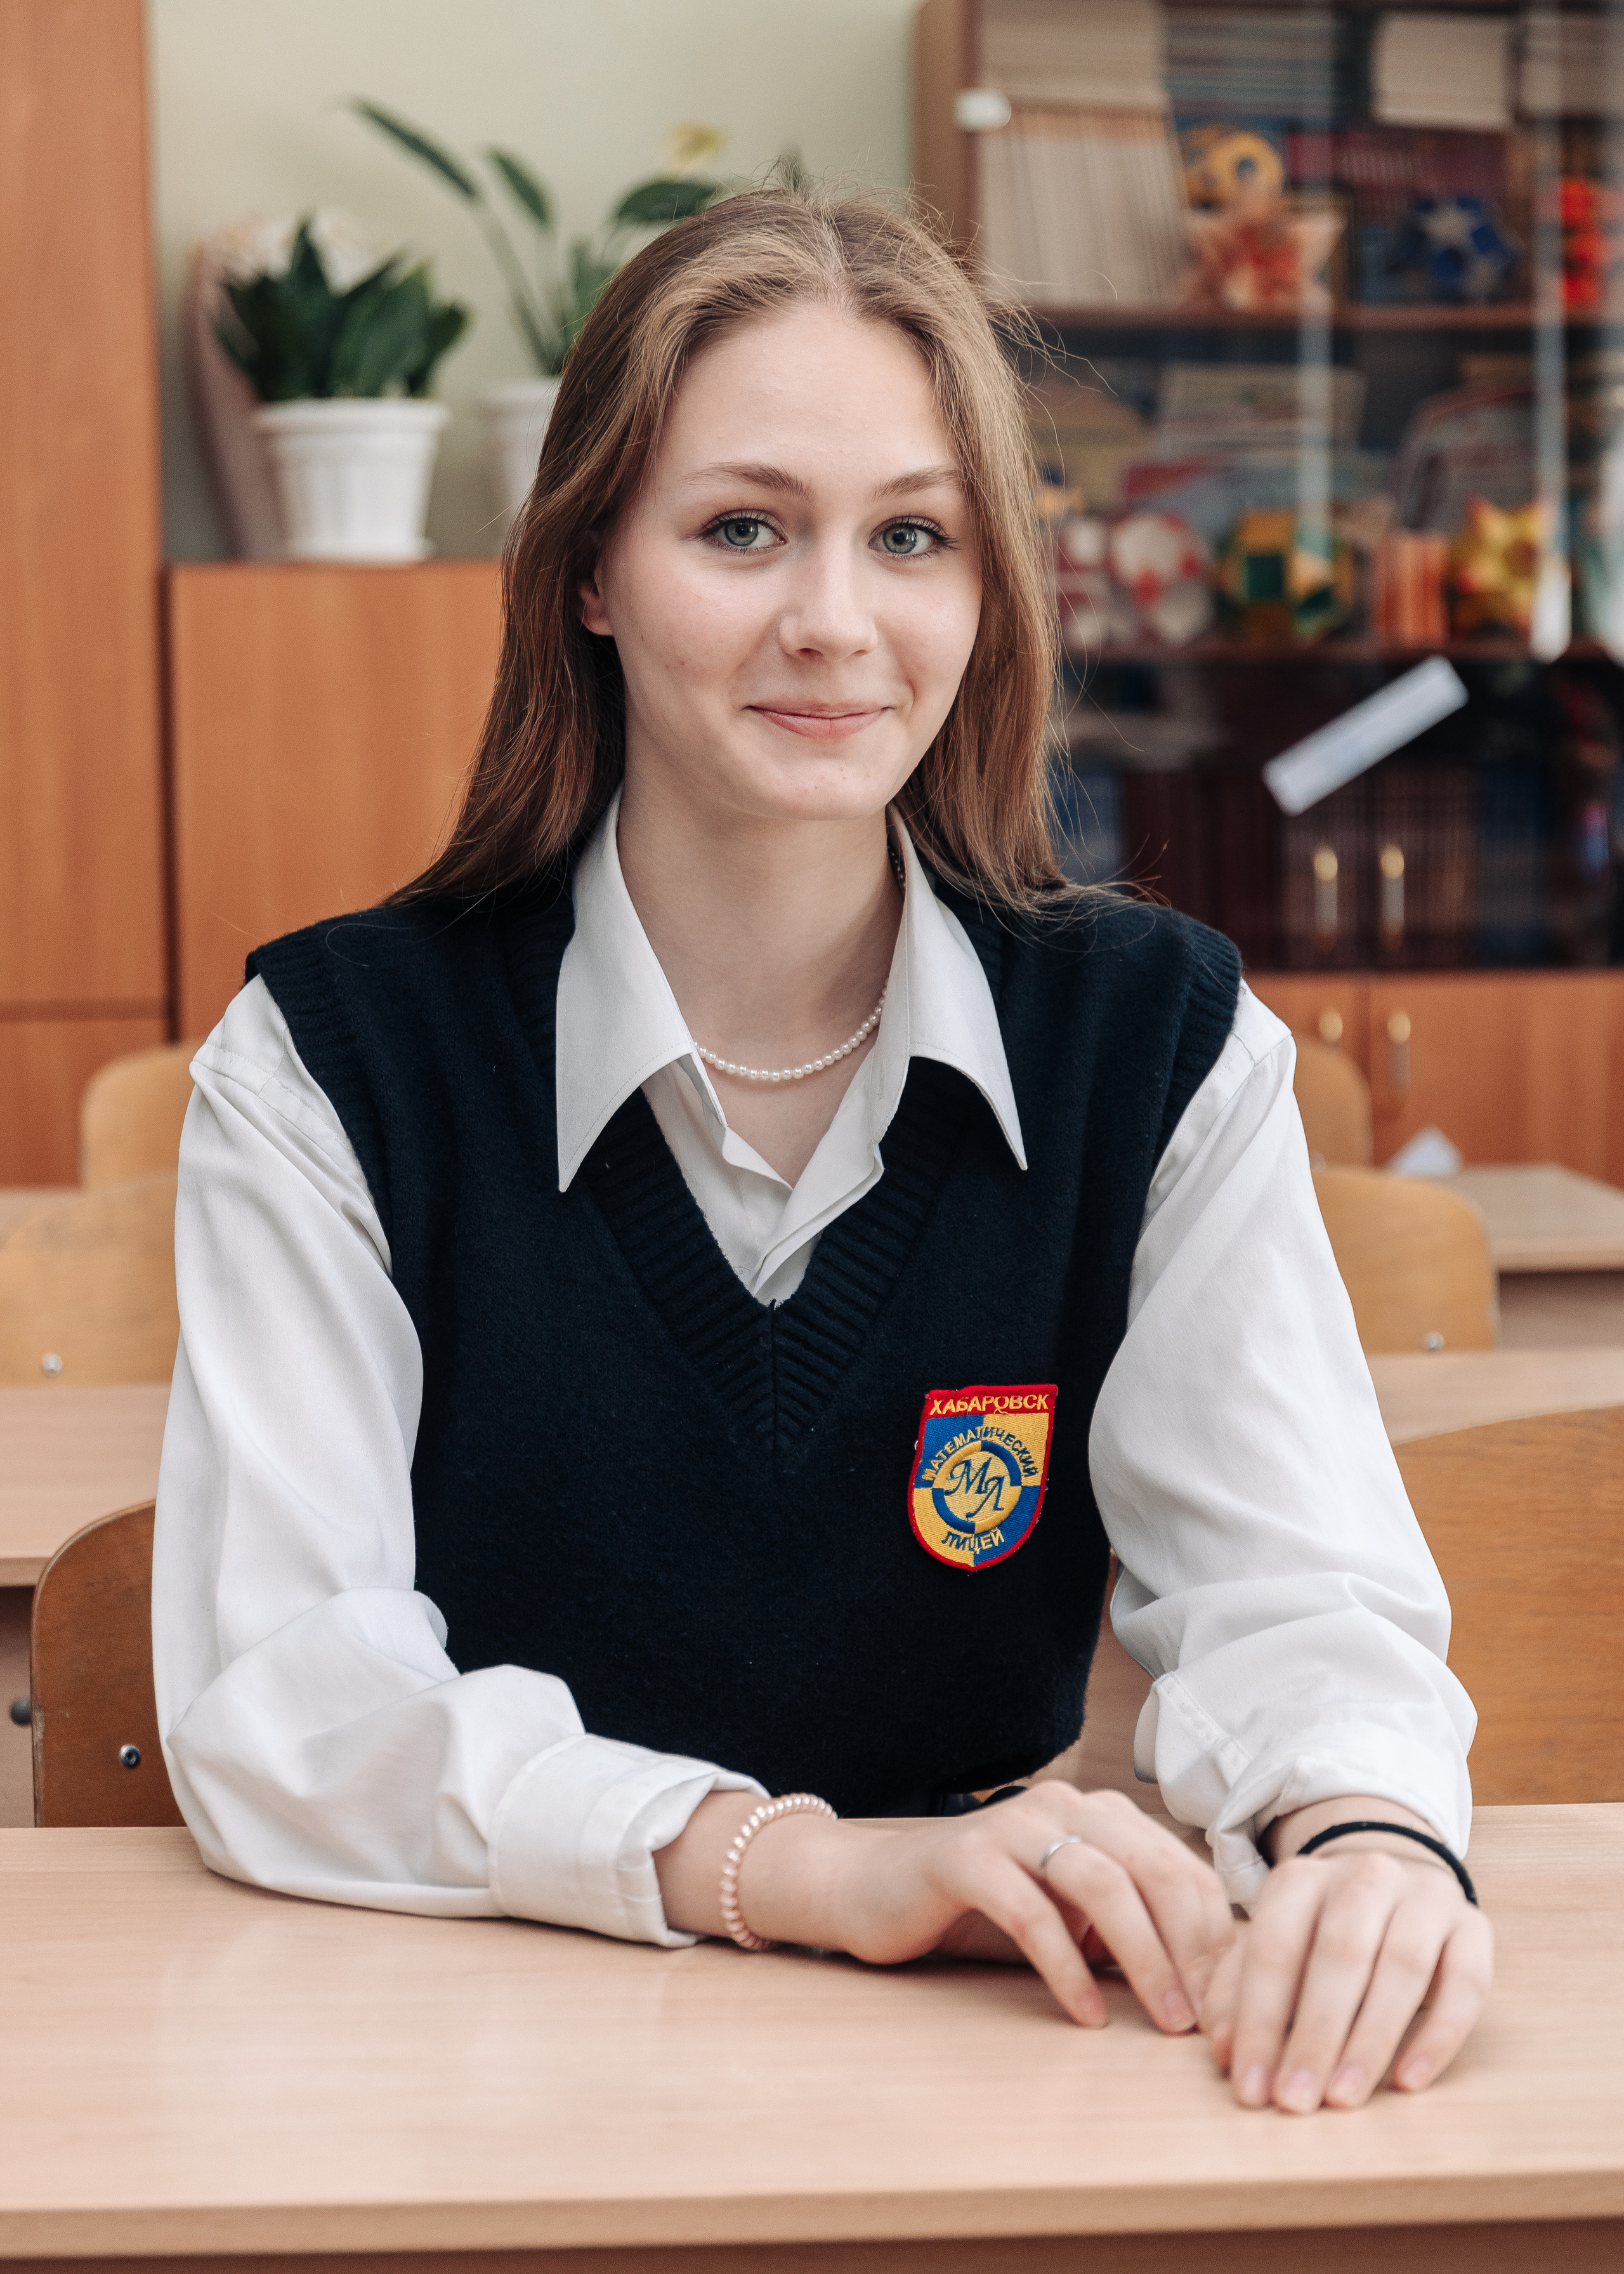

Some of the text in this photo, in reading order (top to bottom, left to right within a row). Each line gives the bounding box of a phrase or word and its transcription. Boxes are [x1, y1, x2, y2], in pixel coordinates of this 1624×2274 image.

[930, 1394, 1050, 1416] ХАБАРОВСК
[922, 1426, 1038, 1481] МАТЕМАТИЧЕСКИЙ
[941, 1527, 1004, 1554] ЛИЦЕЙ
